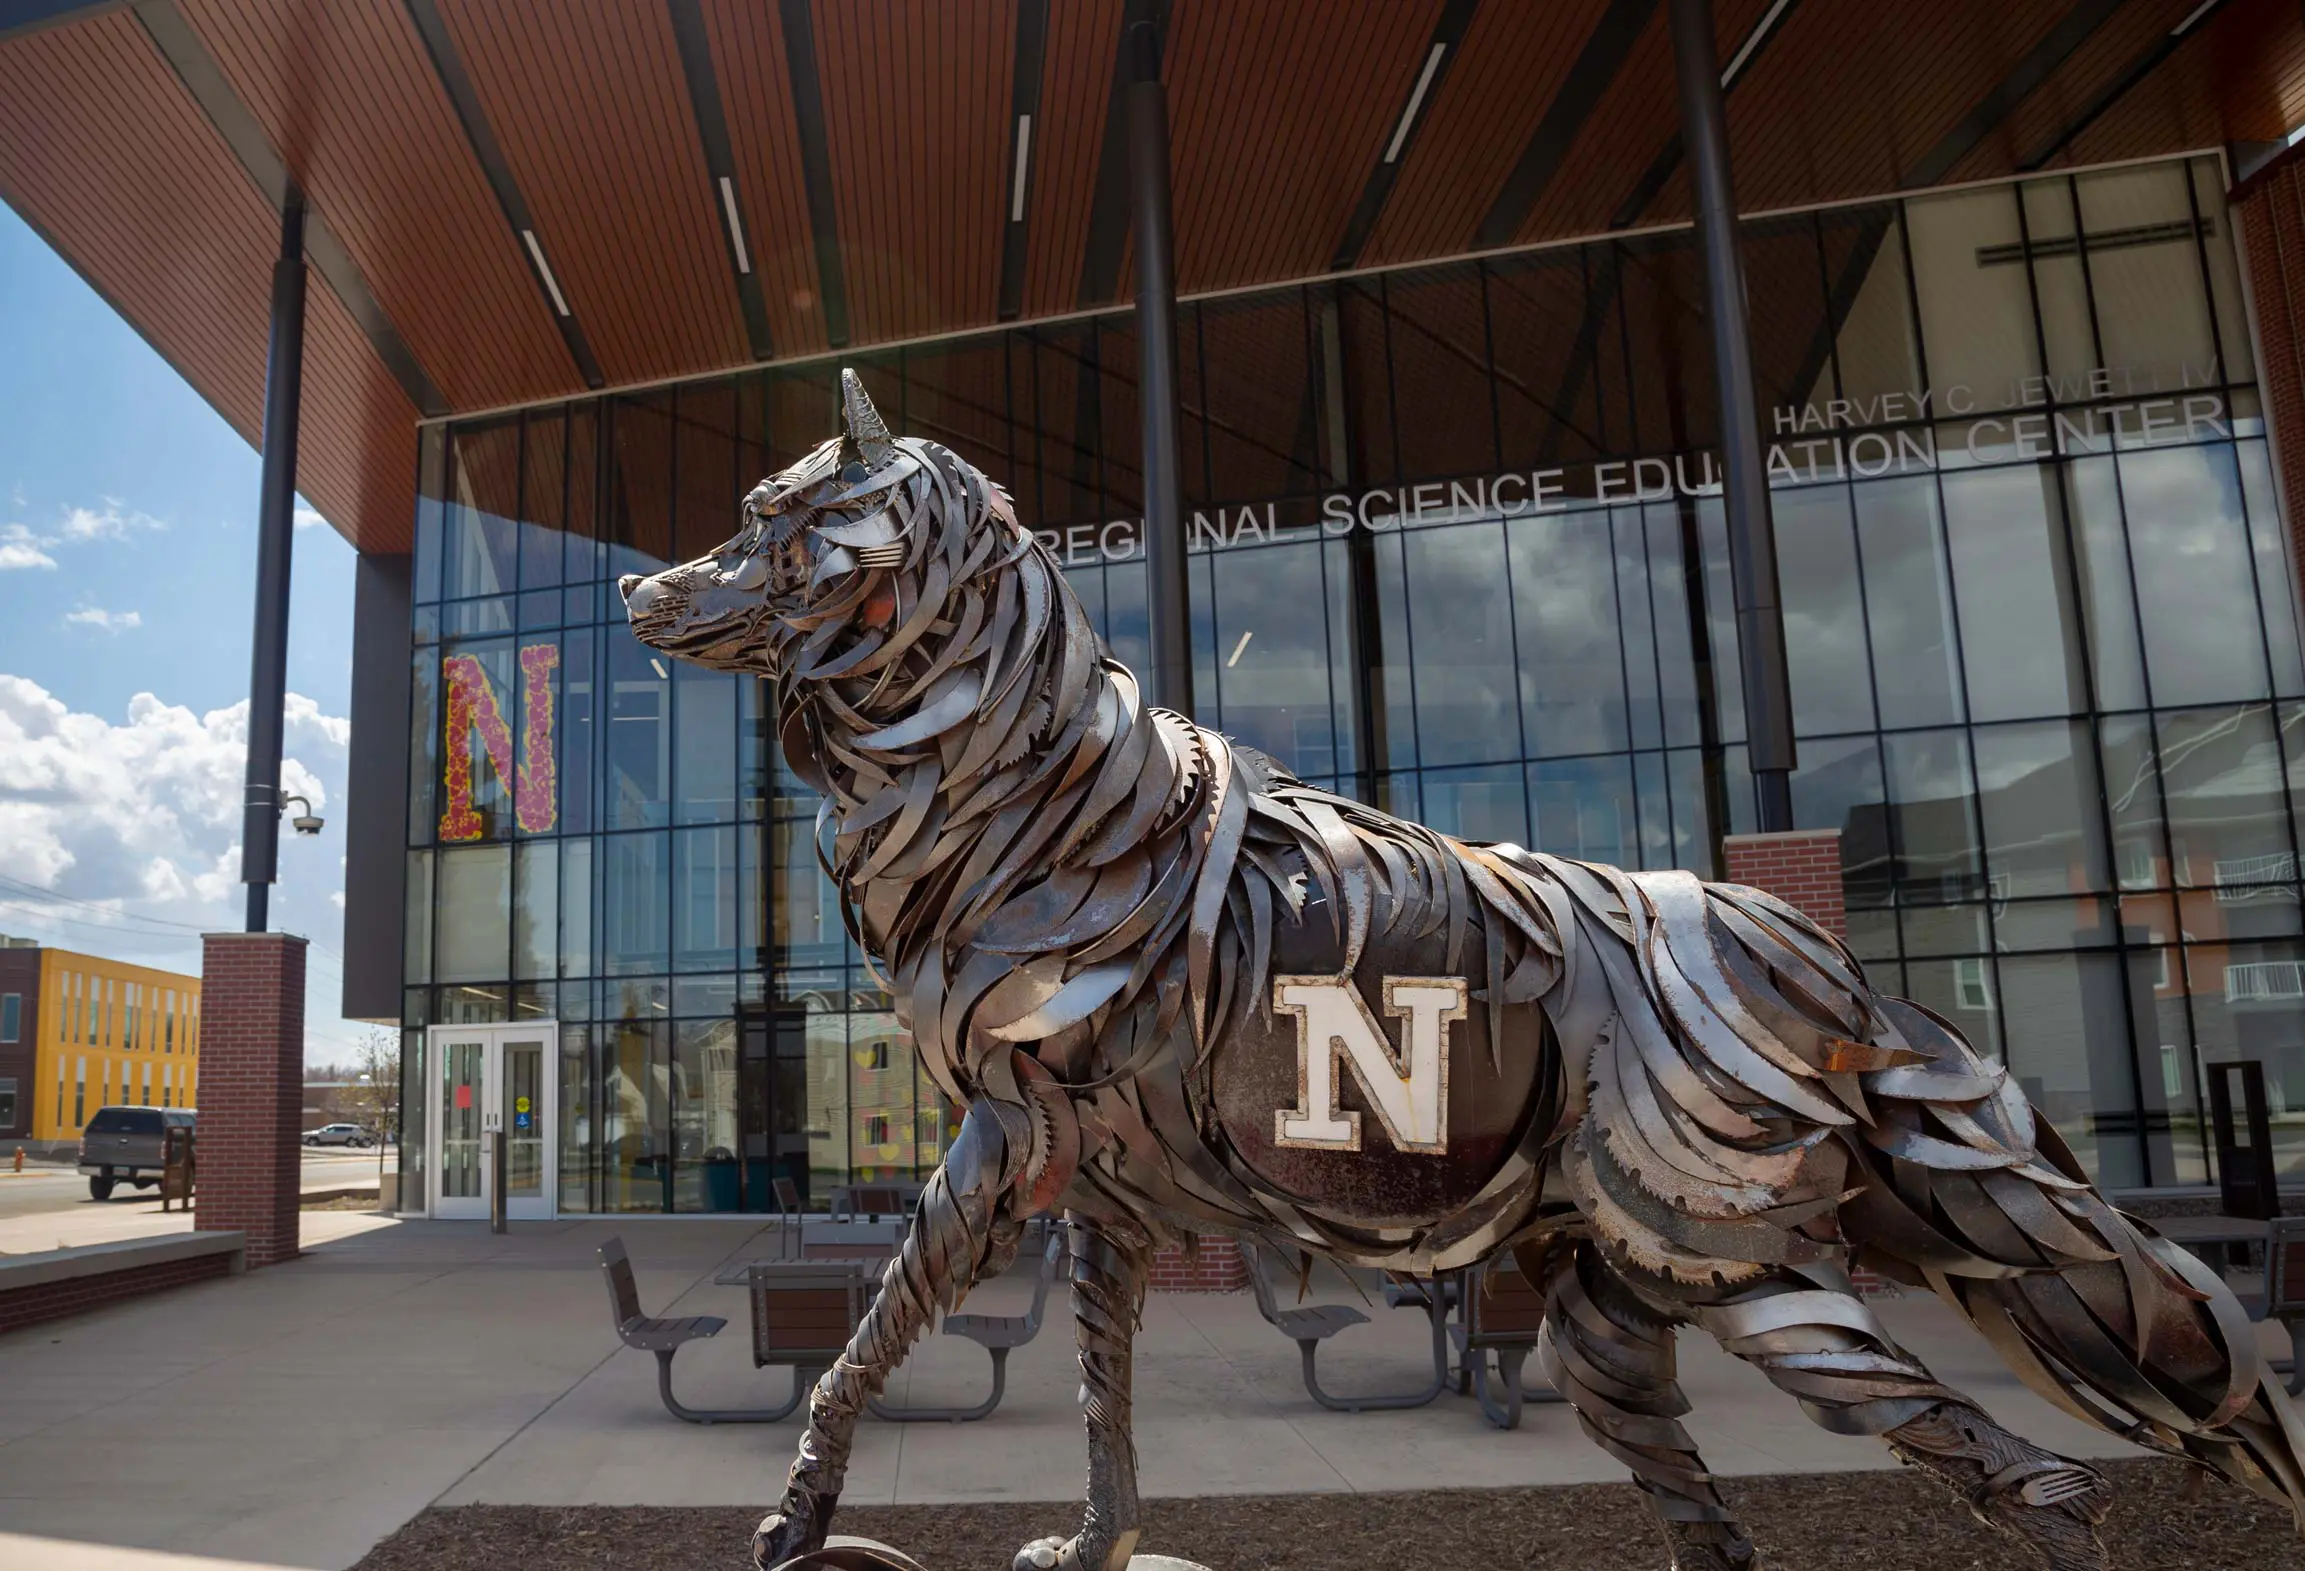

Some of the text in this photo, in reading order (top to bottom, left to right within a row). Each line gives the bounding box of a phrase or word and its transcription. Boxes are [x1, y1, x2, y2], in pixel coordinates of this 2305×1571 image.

[1031, 395, 2230, 566] REGINAL SCIENCE EDUATION CENTER
[1773, 389, 1933, 435] HARVEY
[439, 643, 560, 842] N
[1272, 974, 1469, 1156] N
